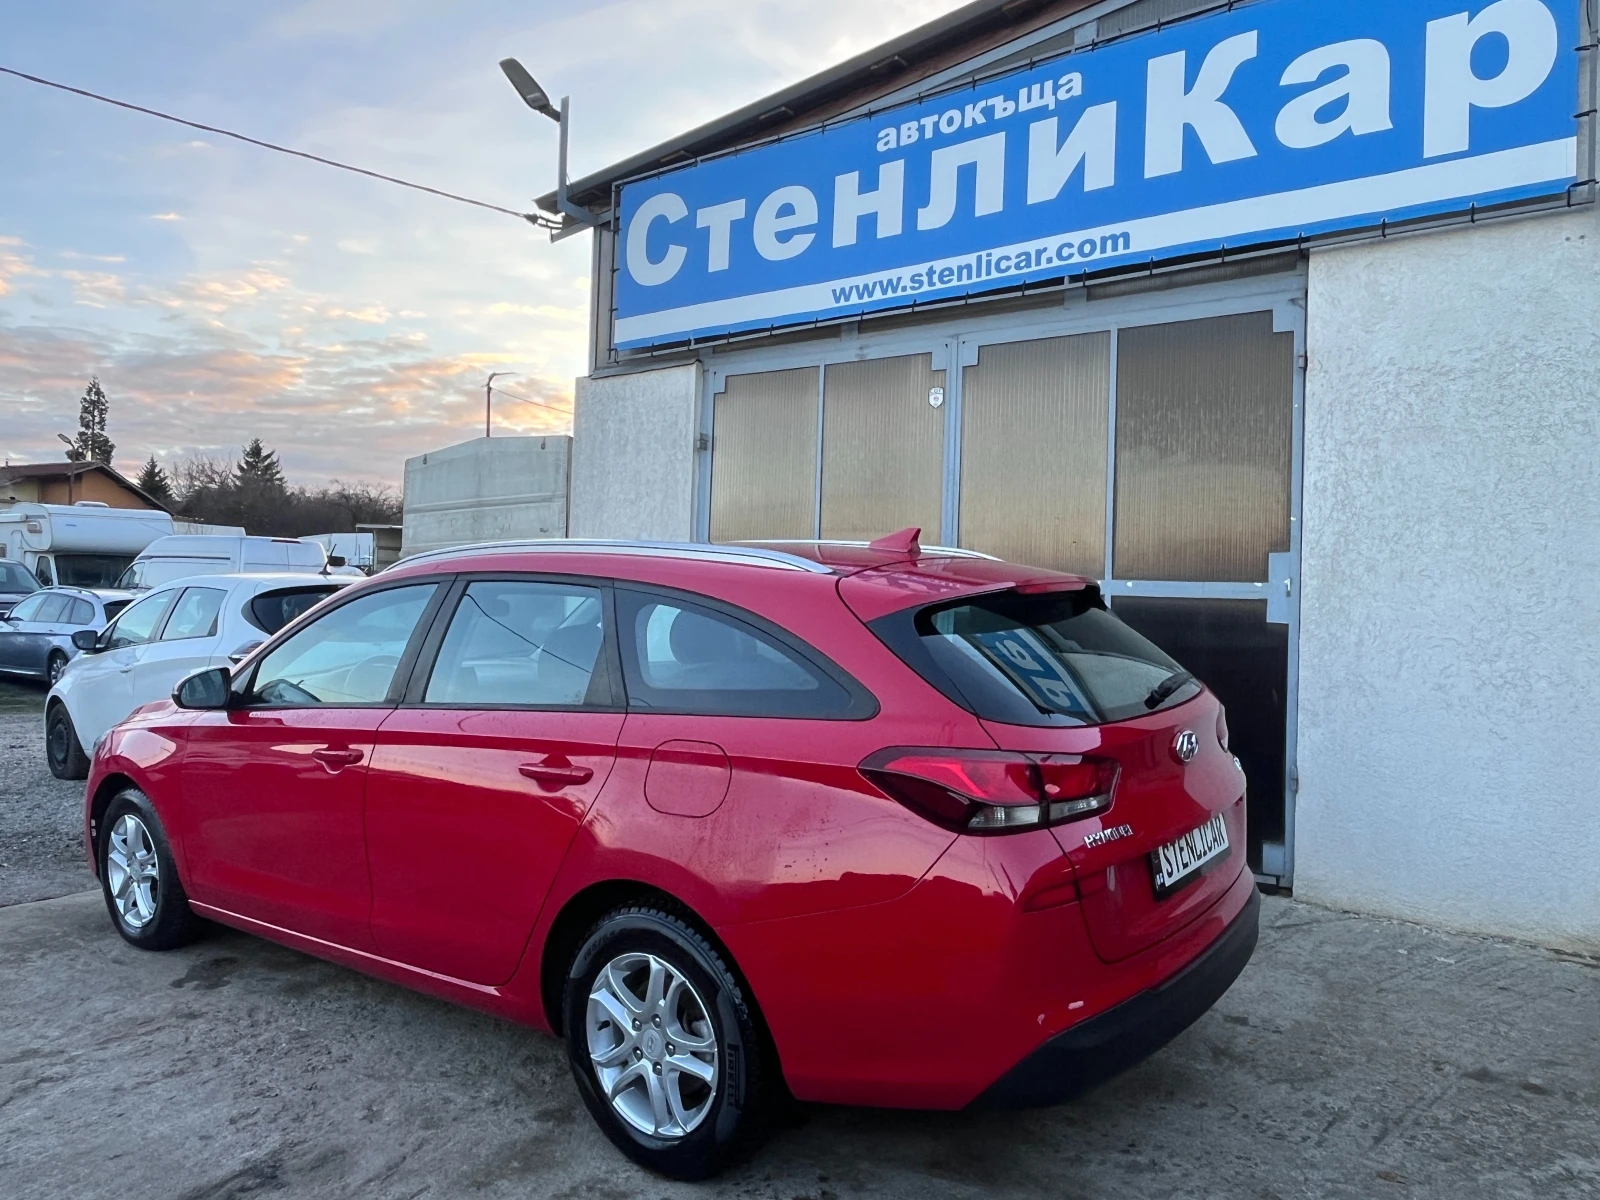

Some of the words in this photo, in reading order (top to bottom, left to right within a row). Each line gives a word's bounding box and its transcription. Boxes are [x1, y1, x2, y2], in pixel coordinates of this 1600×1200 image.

[876, 71, 1083, 152] автокъща
[831, 231, 1131, 304] www.stenlicar.com
[1162, 817, 1226, 879] STENLICAR
